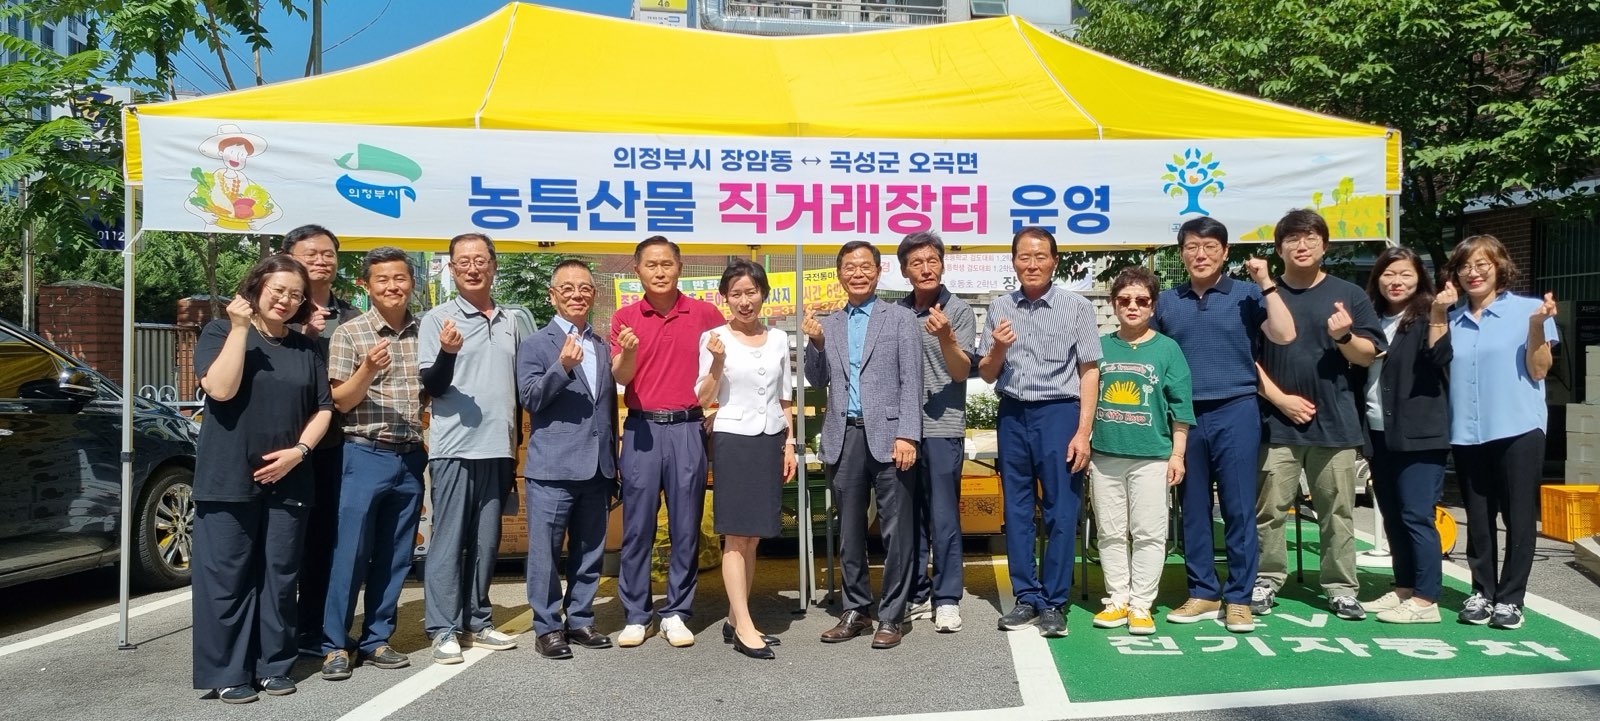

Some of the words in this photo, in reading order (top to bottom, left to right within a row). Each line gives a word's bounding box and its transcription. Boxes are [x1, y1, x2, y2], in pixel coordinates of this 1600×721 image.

[613, 147, 711, 171] 의정부시
[721, 149, 793, 172] 장암동
[829, 151, 900, 174] 곡성군
[909, 152, 978, 175] 오곡면
[348, 188, 399, 200] 의정부시
[468, 176, 696, 232] 농특산물
[718, 182, 988, 235] 직거래장터
[1009, 184, 1111, 235] 운영
[804, 271, 839, 281] 국전통마
[804, 285, 821, 301] 시간
[1107, 634, 1571, 662] 전기자동차
